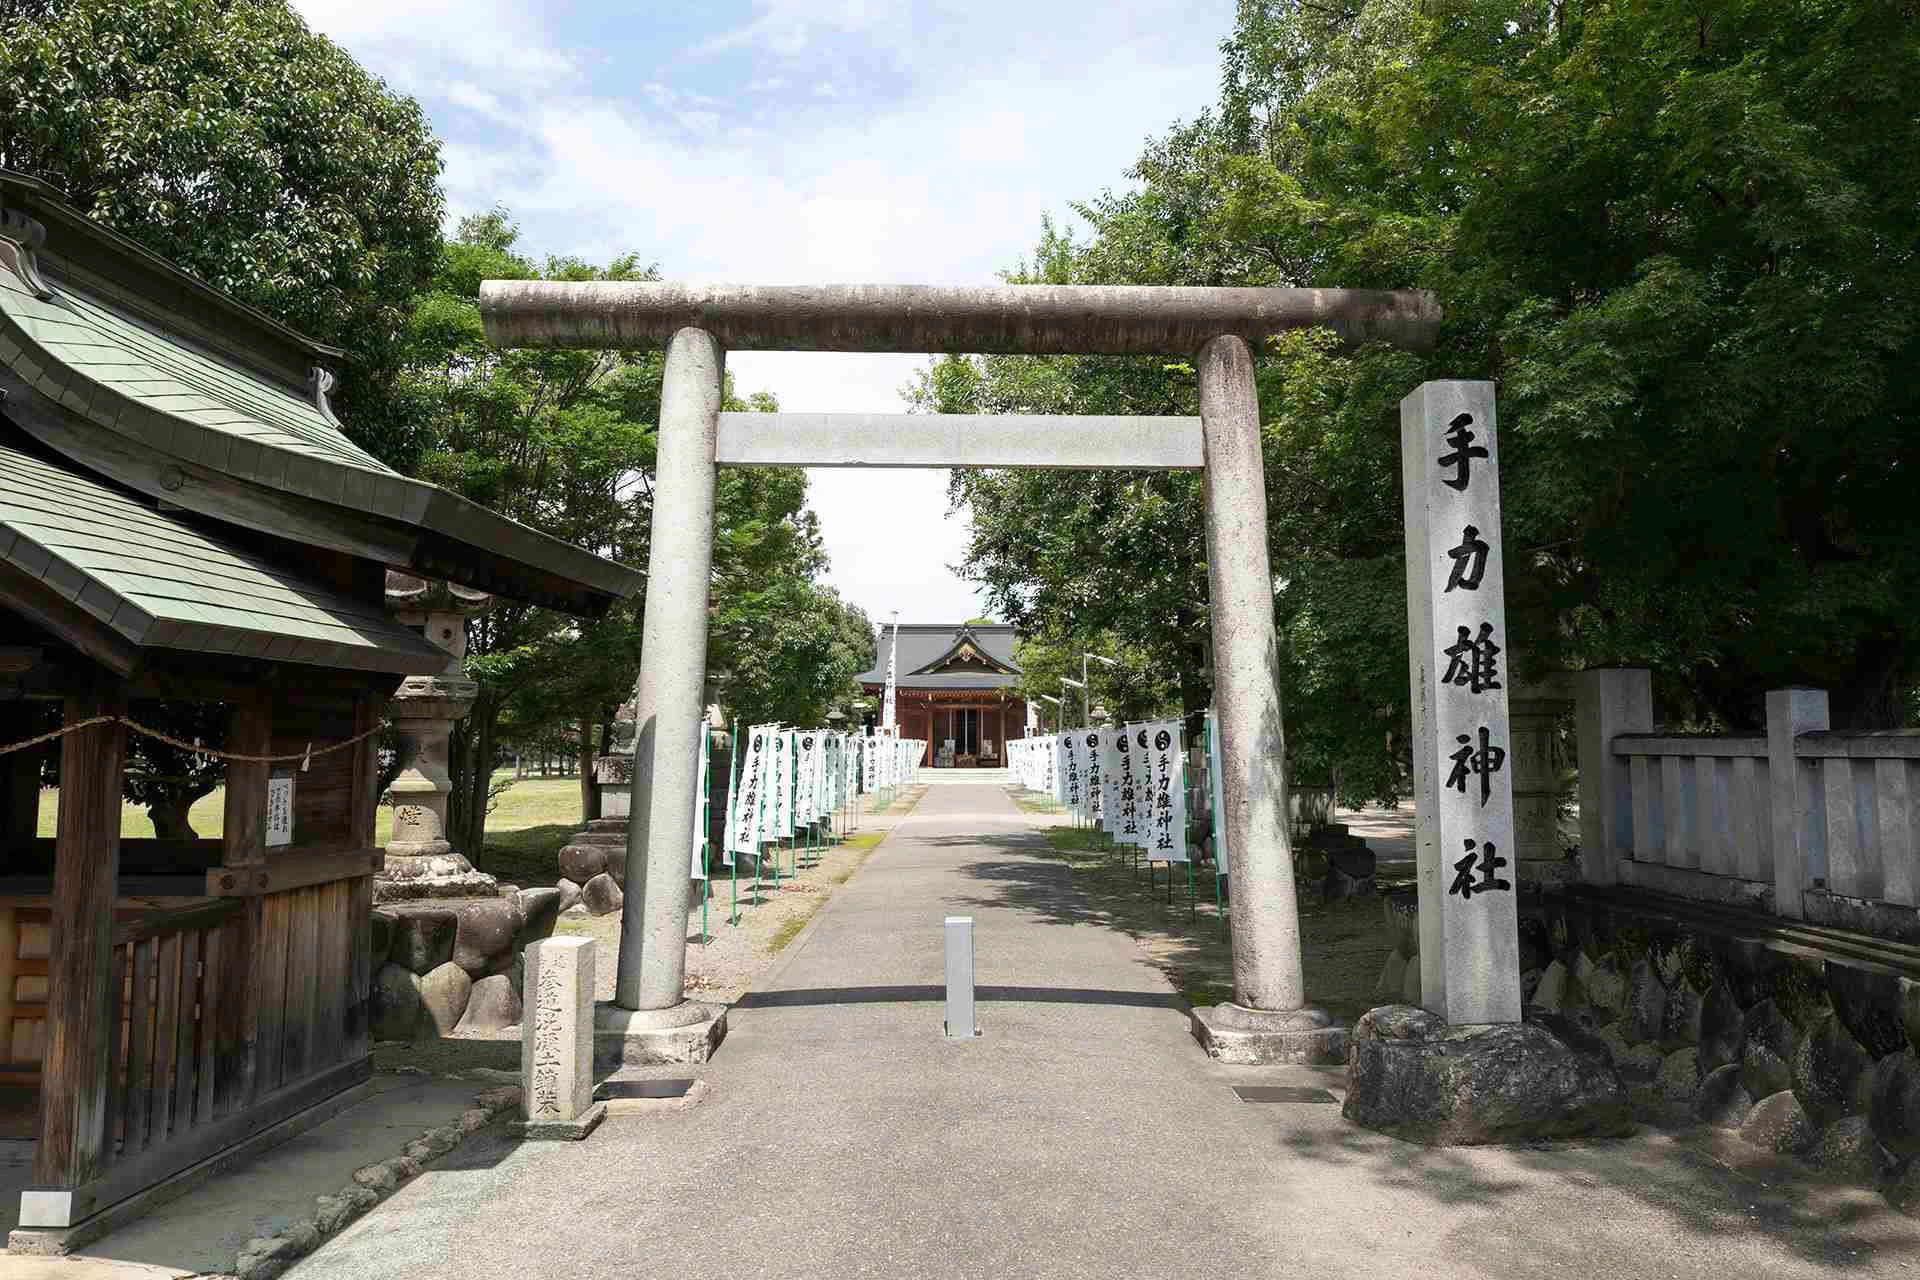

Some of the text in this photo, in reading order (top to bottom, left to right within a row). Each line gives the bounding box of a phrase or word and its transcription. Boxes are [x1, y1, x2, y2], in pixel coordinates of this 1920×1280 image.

[1437, 412, 1511, 900] 手力雄神社
[738, 756, 761, 843] 手力雄神社
[1089, 749, 1102, 812] 手力雄神社
[1120, 754, 1138, 834] 手力雄神社
[1156, 754, 1174, 850] 手力雄神社
